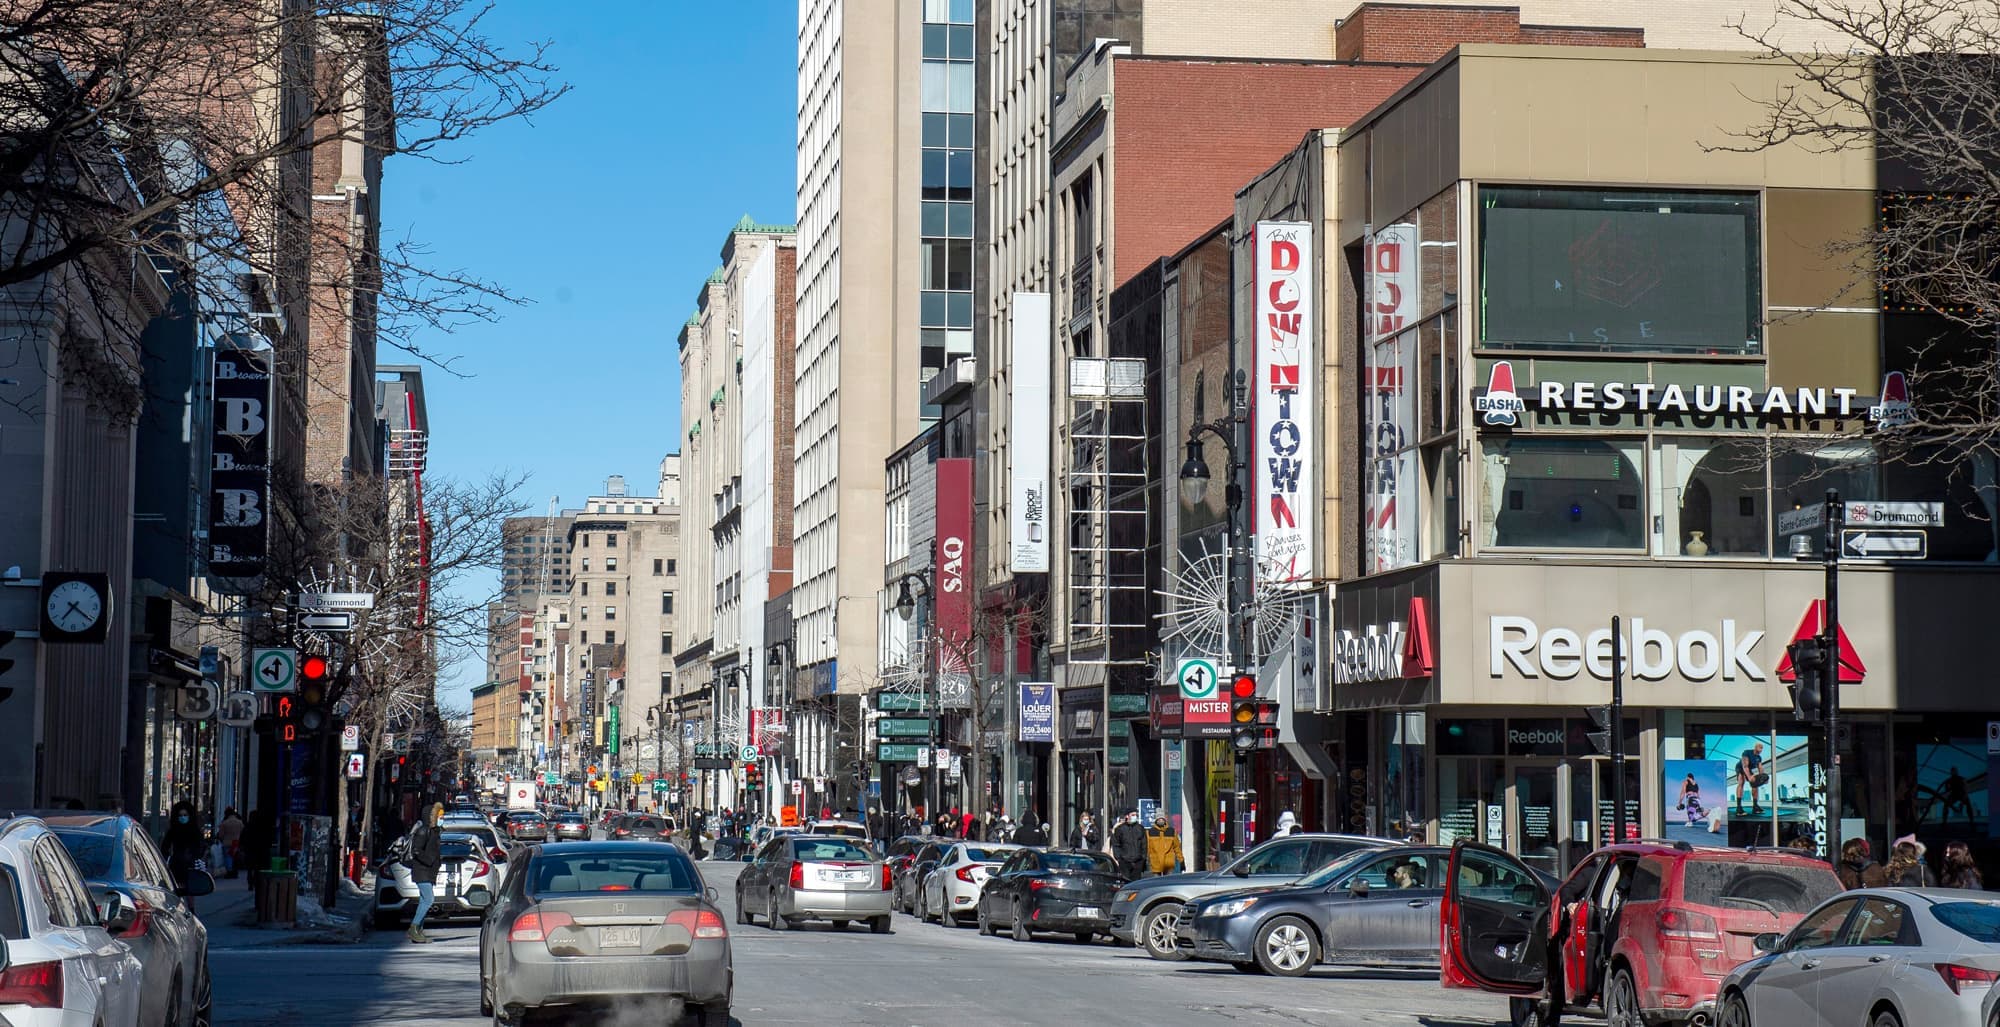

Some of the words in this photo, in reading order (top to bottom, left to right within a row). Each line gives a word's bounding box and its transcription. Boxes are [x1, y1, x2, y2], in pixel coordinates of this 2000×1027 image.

[1266, 229, 1299, 243] Bar
[1268, 240, 1302, 528] DOWNTOWN
[1478, 399, 1523, 411] BASHA
[1540, 381, 1857, 415] RESTAURANT
[217, 398, 265, 435] B
[215, 489, 262, 527] B
[1873, 511, 1939, 522] Drummond
[943, 536, 964, 593] SAQ
[1336, 621, 1404, 685] Reebok
[1490, 615, 1766, 680] Reebok
[881, 695, 892, 708] P
[1023, 704, 1052, 713] LOUER
[1188, 702, 1229, 714] MISTER
[881, 720, 892, 733] P
[1509, 730, 1564, 744] Reebok
[881, 746, 892, 759] P
